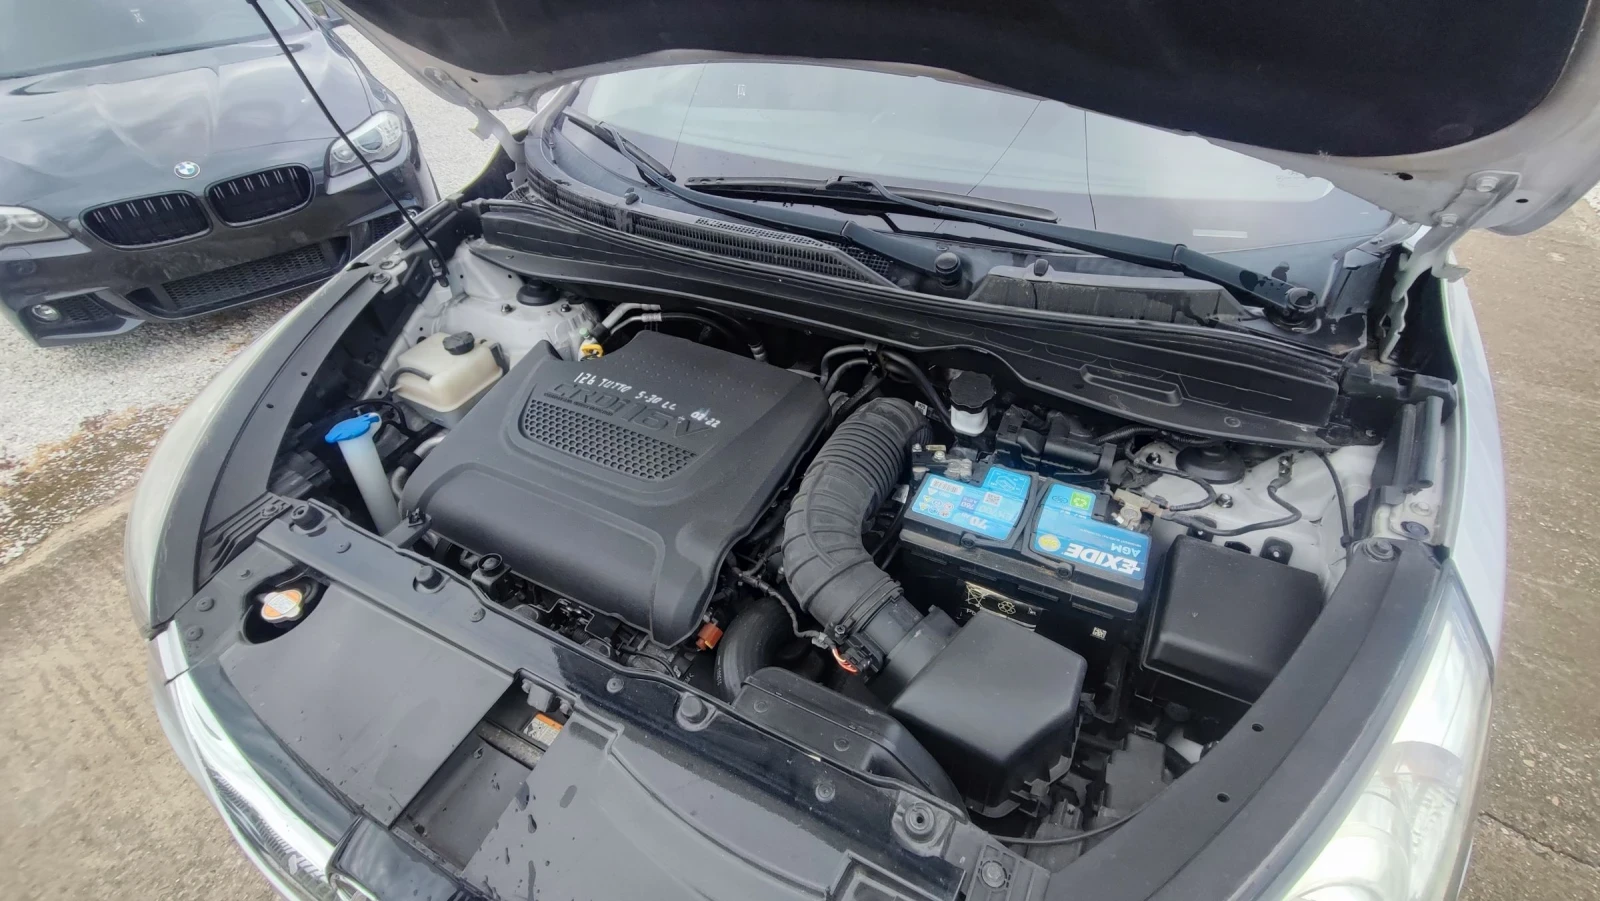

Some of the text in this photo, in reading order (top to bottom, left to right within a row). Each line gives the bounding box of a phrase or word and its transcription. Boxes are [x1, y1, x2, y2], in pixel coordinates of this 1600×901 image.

[598, 378, 632, 393] TUTTO
[960, 501, 975, 510] 760
[969, 517, 989, 530] 70
[1111, 543, 1141, 558] AGM
[1063, 543, 1141, 575] EXIDE
